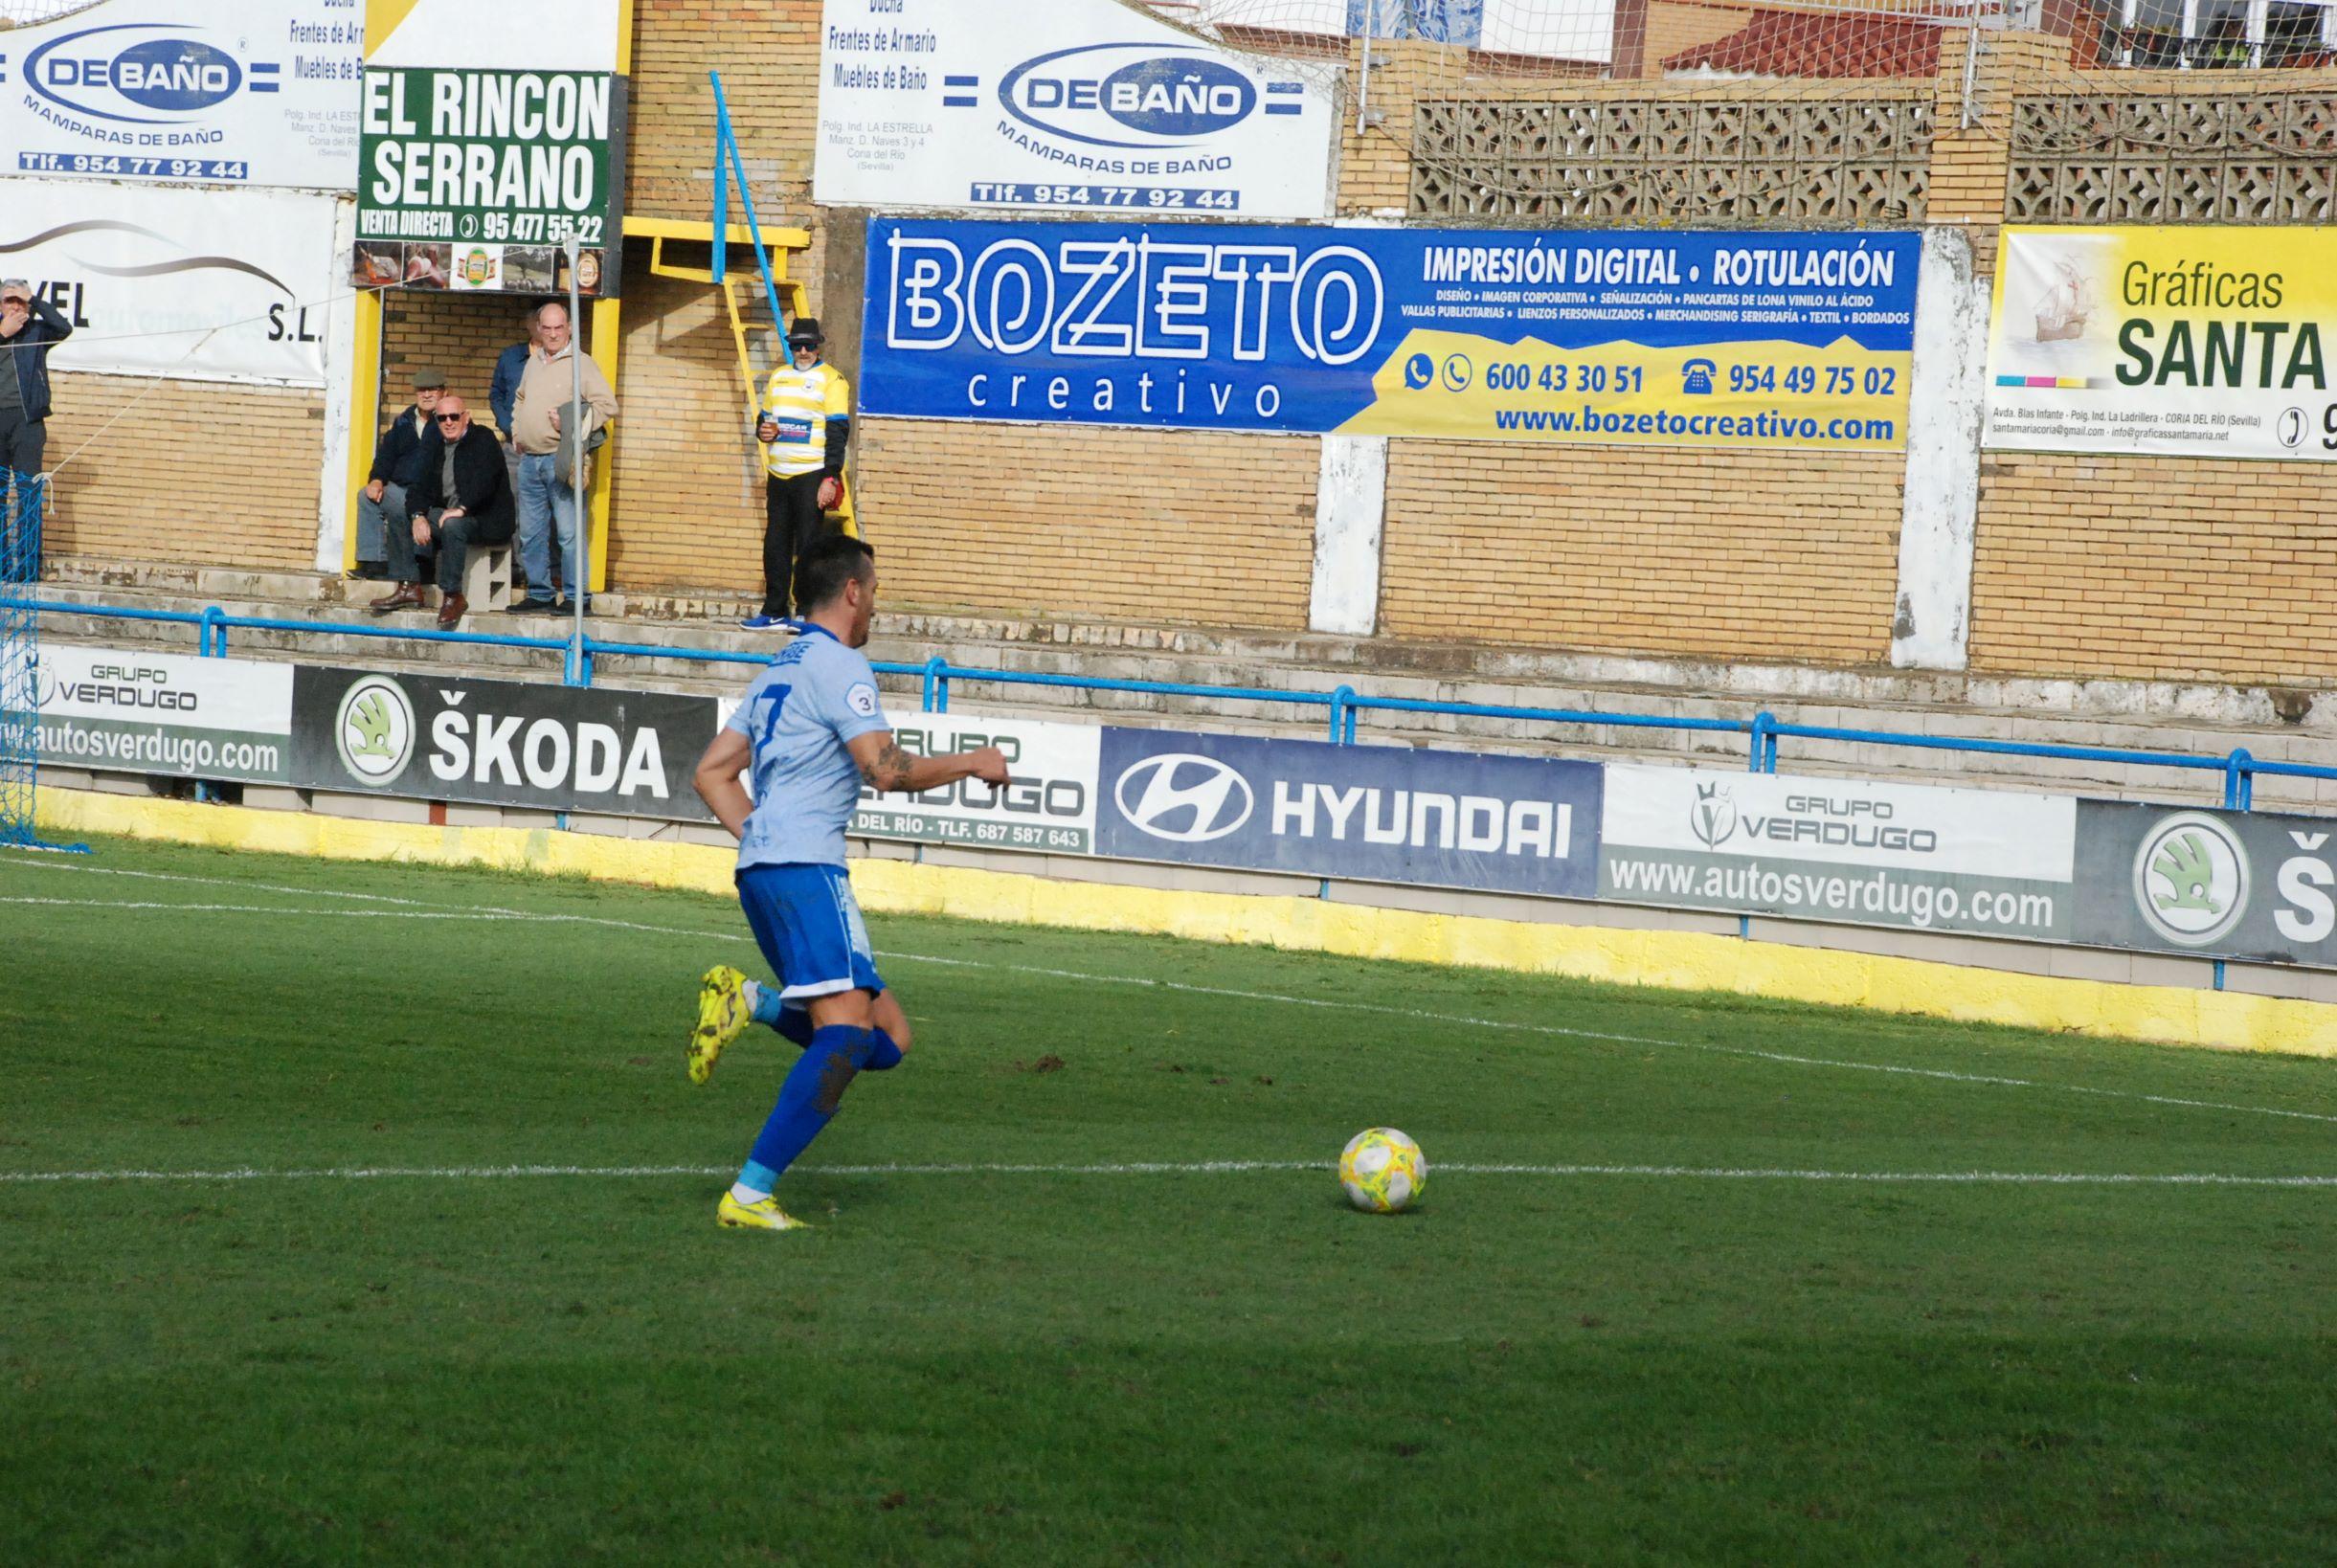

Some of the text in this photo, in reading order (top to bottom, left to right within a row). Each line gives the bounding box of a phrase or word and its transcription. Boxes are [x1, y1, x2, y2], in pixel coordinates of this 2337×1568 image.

[290, 19, 327, 43] Frentes
[331, 21, 344, 44] de
[829, 26, 936, 53] Frentes de Armario
[295, 55, 336, 79] Muebles
[340, 56, 352, 79] de
[833, 63, 927, 90] Muebles de Baño
[23, 95, 224, 146] MAMPARAS DE BAÑO
[362, 71, 611, 141] EL RINCON
[866, 122, 880, 132] LA
[883, 122, 933, 134] ESTRELLA
[872, 135, 900, 146] Naves
[918, 137, 925, 146] 4
[874, 148, 888, 159] del
[997, 120, 1232, 174] MAMPARAS DE BAÑO
[21, 153, 244, 179] Tlf. 954 77 92 44
[371, 140, 595, 212] SERRANO
[975, 184, 1234, 209] Tlf. 954 77 92 44
[360, 209, 603, 243] VENTA DIRECTA 95 477 55 22
[1423, 237, 1896, 287] IMPRESIÓN DIGITAL ROTULACIÓN
[887, 228, 1384, 365] BOZETO
[1436, 288, 1875, 308] DISEÑO IMAGEN CORPORATIVA SEÑALIZACIÓN PANCARTAS DE LONA VINILO AL ÁCIDO
[2122, 259, 2284, 309] Gráficas
[267, 302, 324, 343] S.L.
[1401, 304, 1911, 325] VALLAS PUBLICITARIAS LIENZOS PERSONALIZADOS MERCHANDISING SERIGRAFÍA TEXTIL BORDADOS
[2115, 318, 2327, 391] SANTA
[967, 369, 1281, 418] creativo
[1486, 363, 1897, 395] 600 43 30 51 954 49 75 02
[1495, 405, 1894, 440] www.bozetocreativo.com
[2017, 408, 2035, 419] Blas
[2036, 409, 2065, 420] Infante
[2108, 411, 2119, 422] La
[2120, 412, 2159, 423] Ladrillera
[2165, 413, 2191, 424] CORIA
[2193, 414, 2209, 425] DEL
[2227, 415, 2261, 428] (Sevilla)
[91, 664, 168, 684] GRUPO
[58, 682, 198, 712] VERDUGO
[429, 689, 670, 799] ŠKODA
[891, 728, 1021, 764] RUPO
[1271, 780, 1572, 859] HYUNDAI
[1786, 795, 1894, 820] GRUPO
[858, 814, 890, 832] DEL
[894, 814, 924, 834] RÍO
[937, 820, 973, 839] TLF.
[977, 823, 1008, 841] 687
[1013, 827, 1045, 844] 587
[1048, 830, 1080, 847] 643
[1742, 816, 1938, 854] VERDUGO
[1609, 858, 2055, 928] www.autosverdugo.com
[2273, 831, 2337, 943] Š
